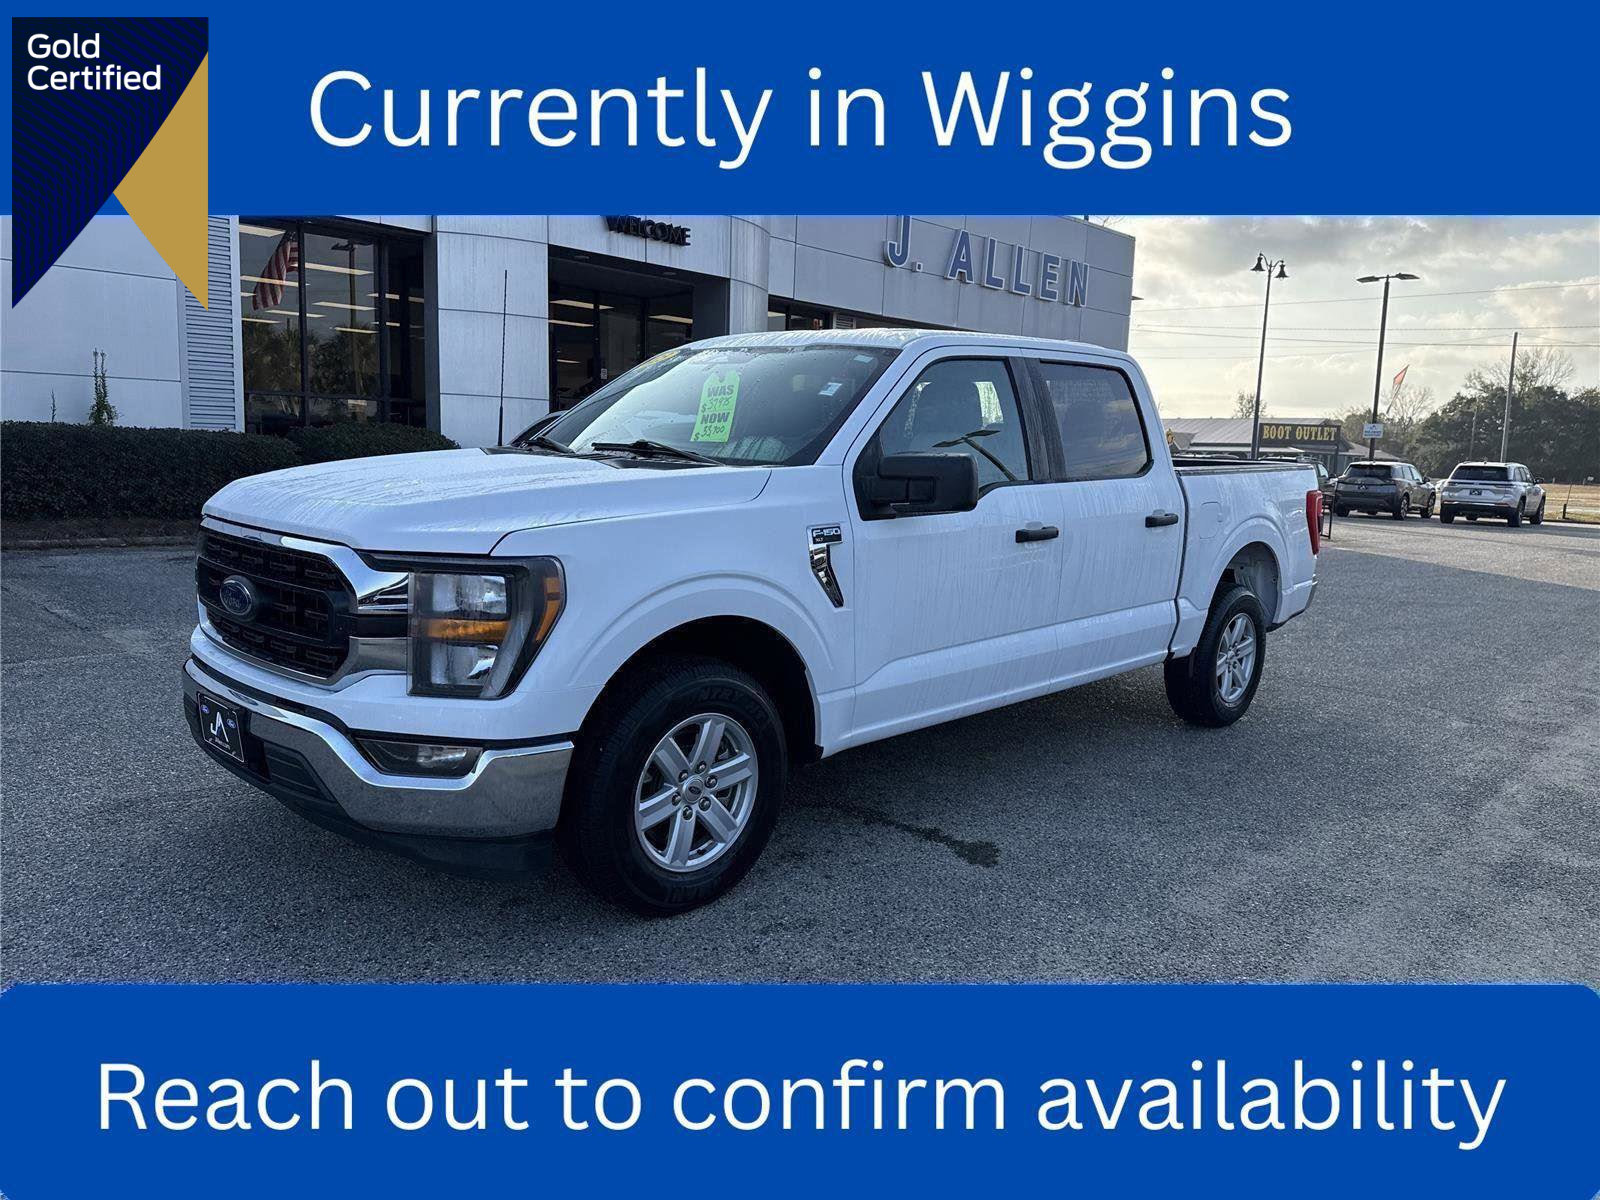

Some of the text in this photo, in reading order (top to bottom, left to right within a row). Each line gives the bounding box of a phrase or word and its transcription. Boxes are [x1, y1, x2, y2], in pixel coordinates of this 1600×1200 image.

[602, 215, 691, 246] WELCOME
[886, 215, 1089, 308] J. ALLEN
[707, 385, 734, 397] WAS
[700, 412, 730, 424] NOW
[1263, 425, 1337, 440] BOOT OUTLET
[813, 528, 841, 537] F-150
